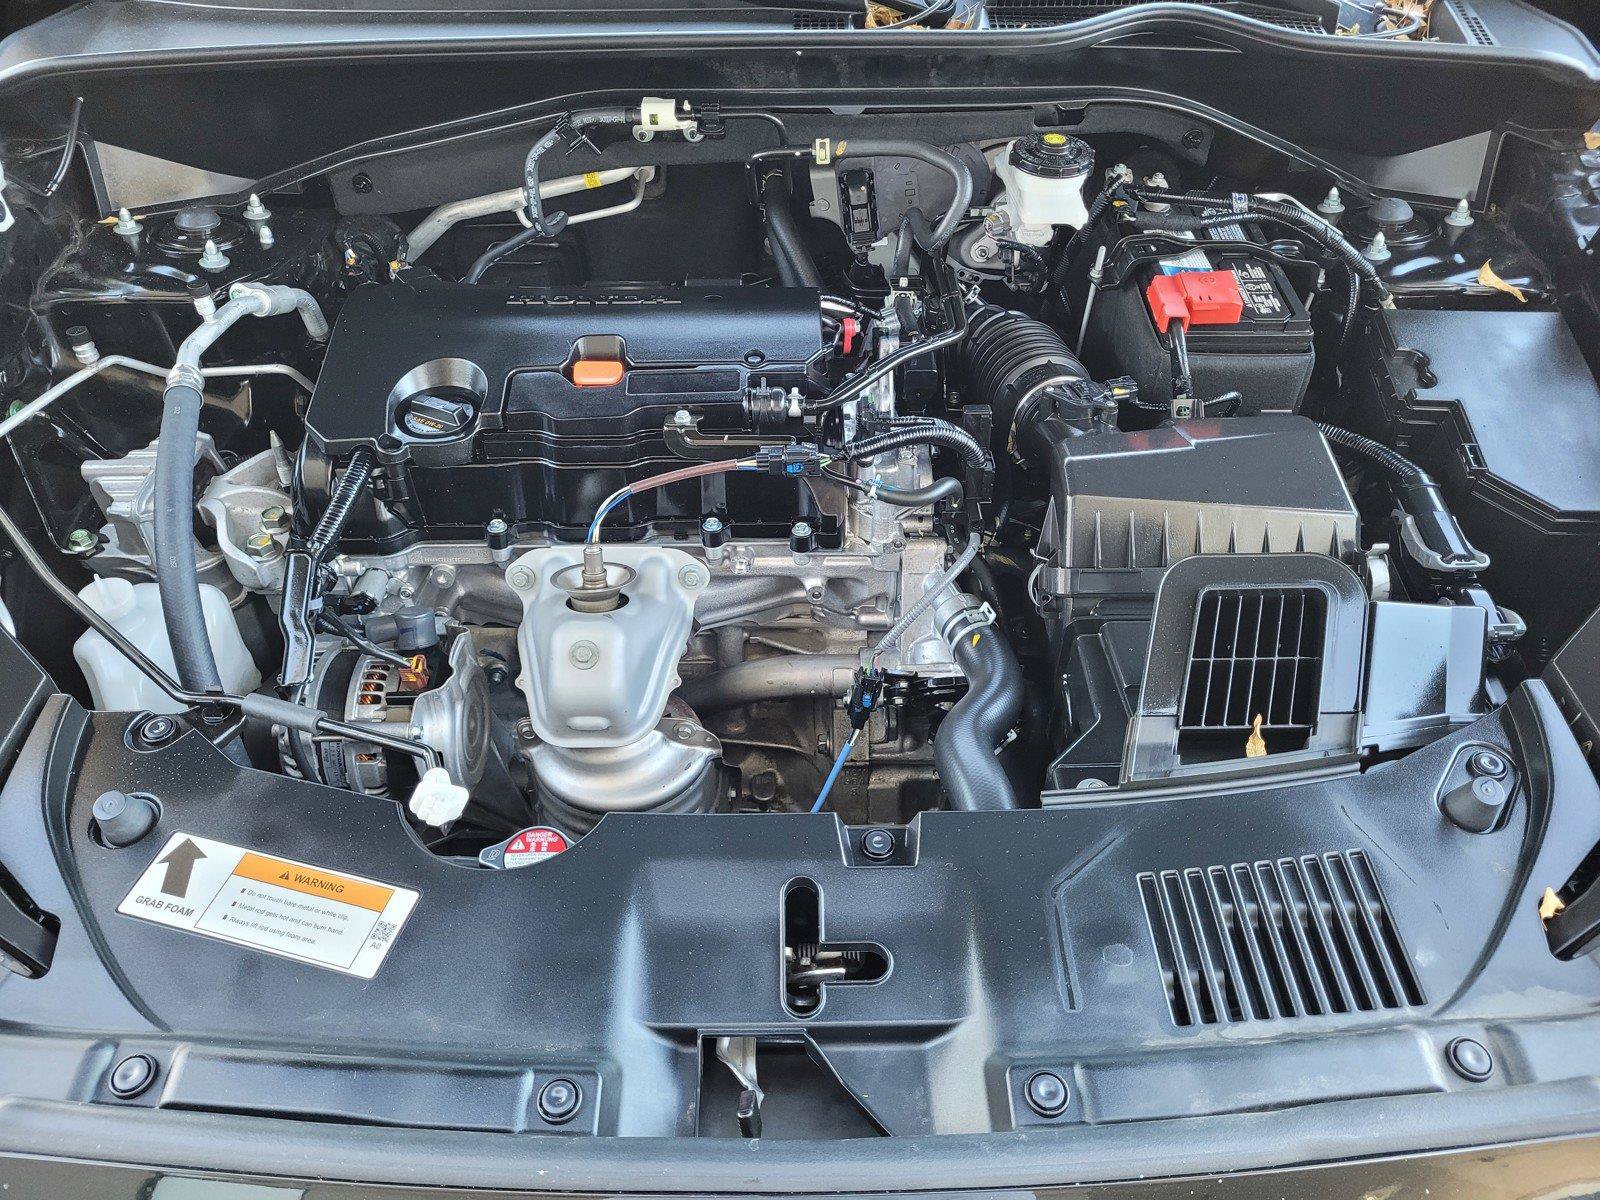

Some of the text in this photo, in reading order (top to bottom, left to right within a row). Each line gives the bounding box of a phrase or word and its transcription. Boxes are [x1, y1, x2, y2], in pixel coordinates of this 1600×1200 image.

[294, 873, 344, 893] WARNING
[135, 895, 194, 916] GRAB FOAM
[238, 902, 255, 911] Metal
[267, 895, 283, 903] touch
[284, 898, 297, 907] bare
[321, 910, 337, 918] white
[229, 916, 250, 926] Always
[250, 921, 259, 929] lift
[269, 928, 286, 937] using
[286, 931, 301, 940] foam
